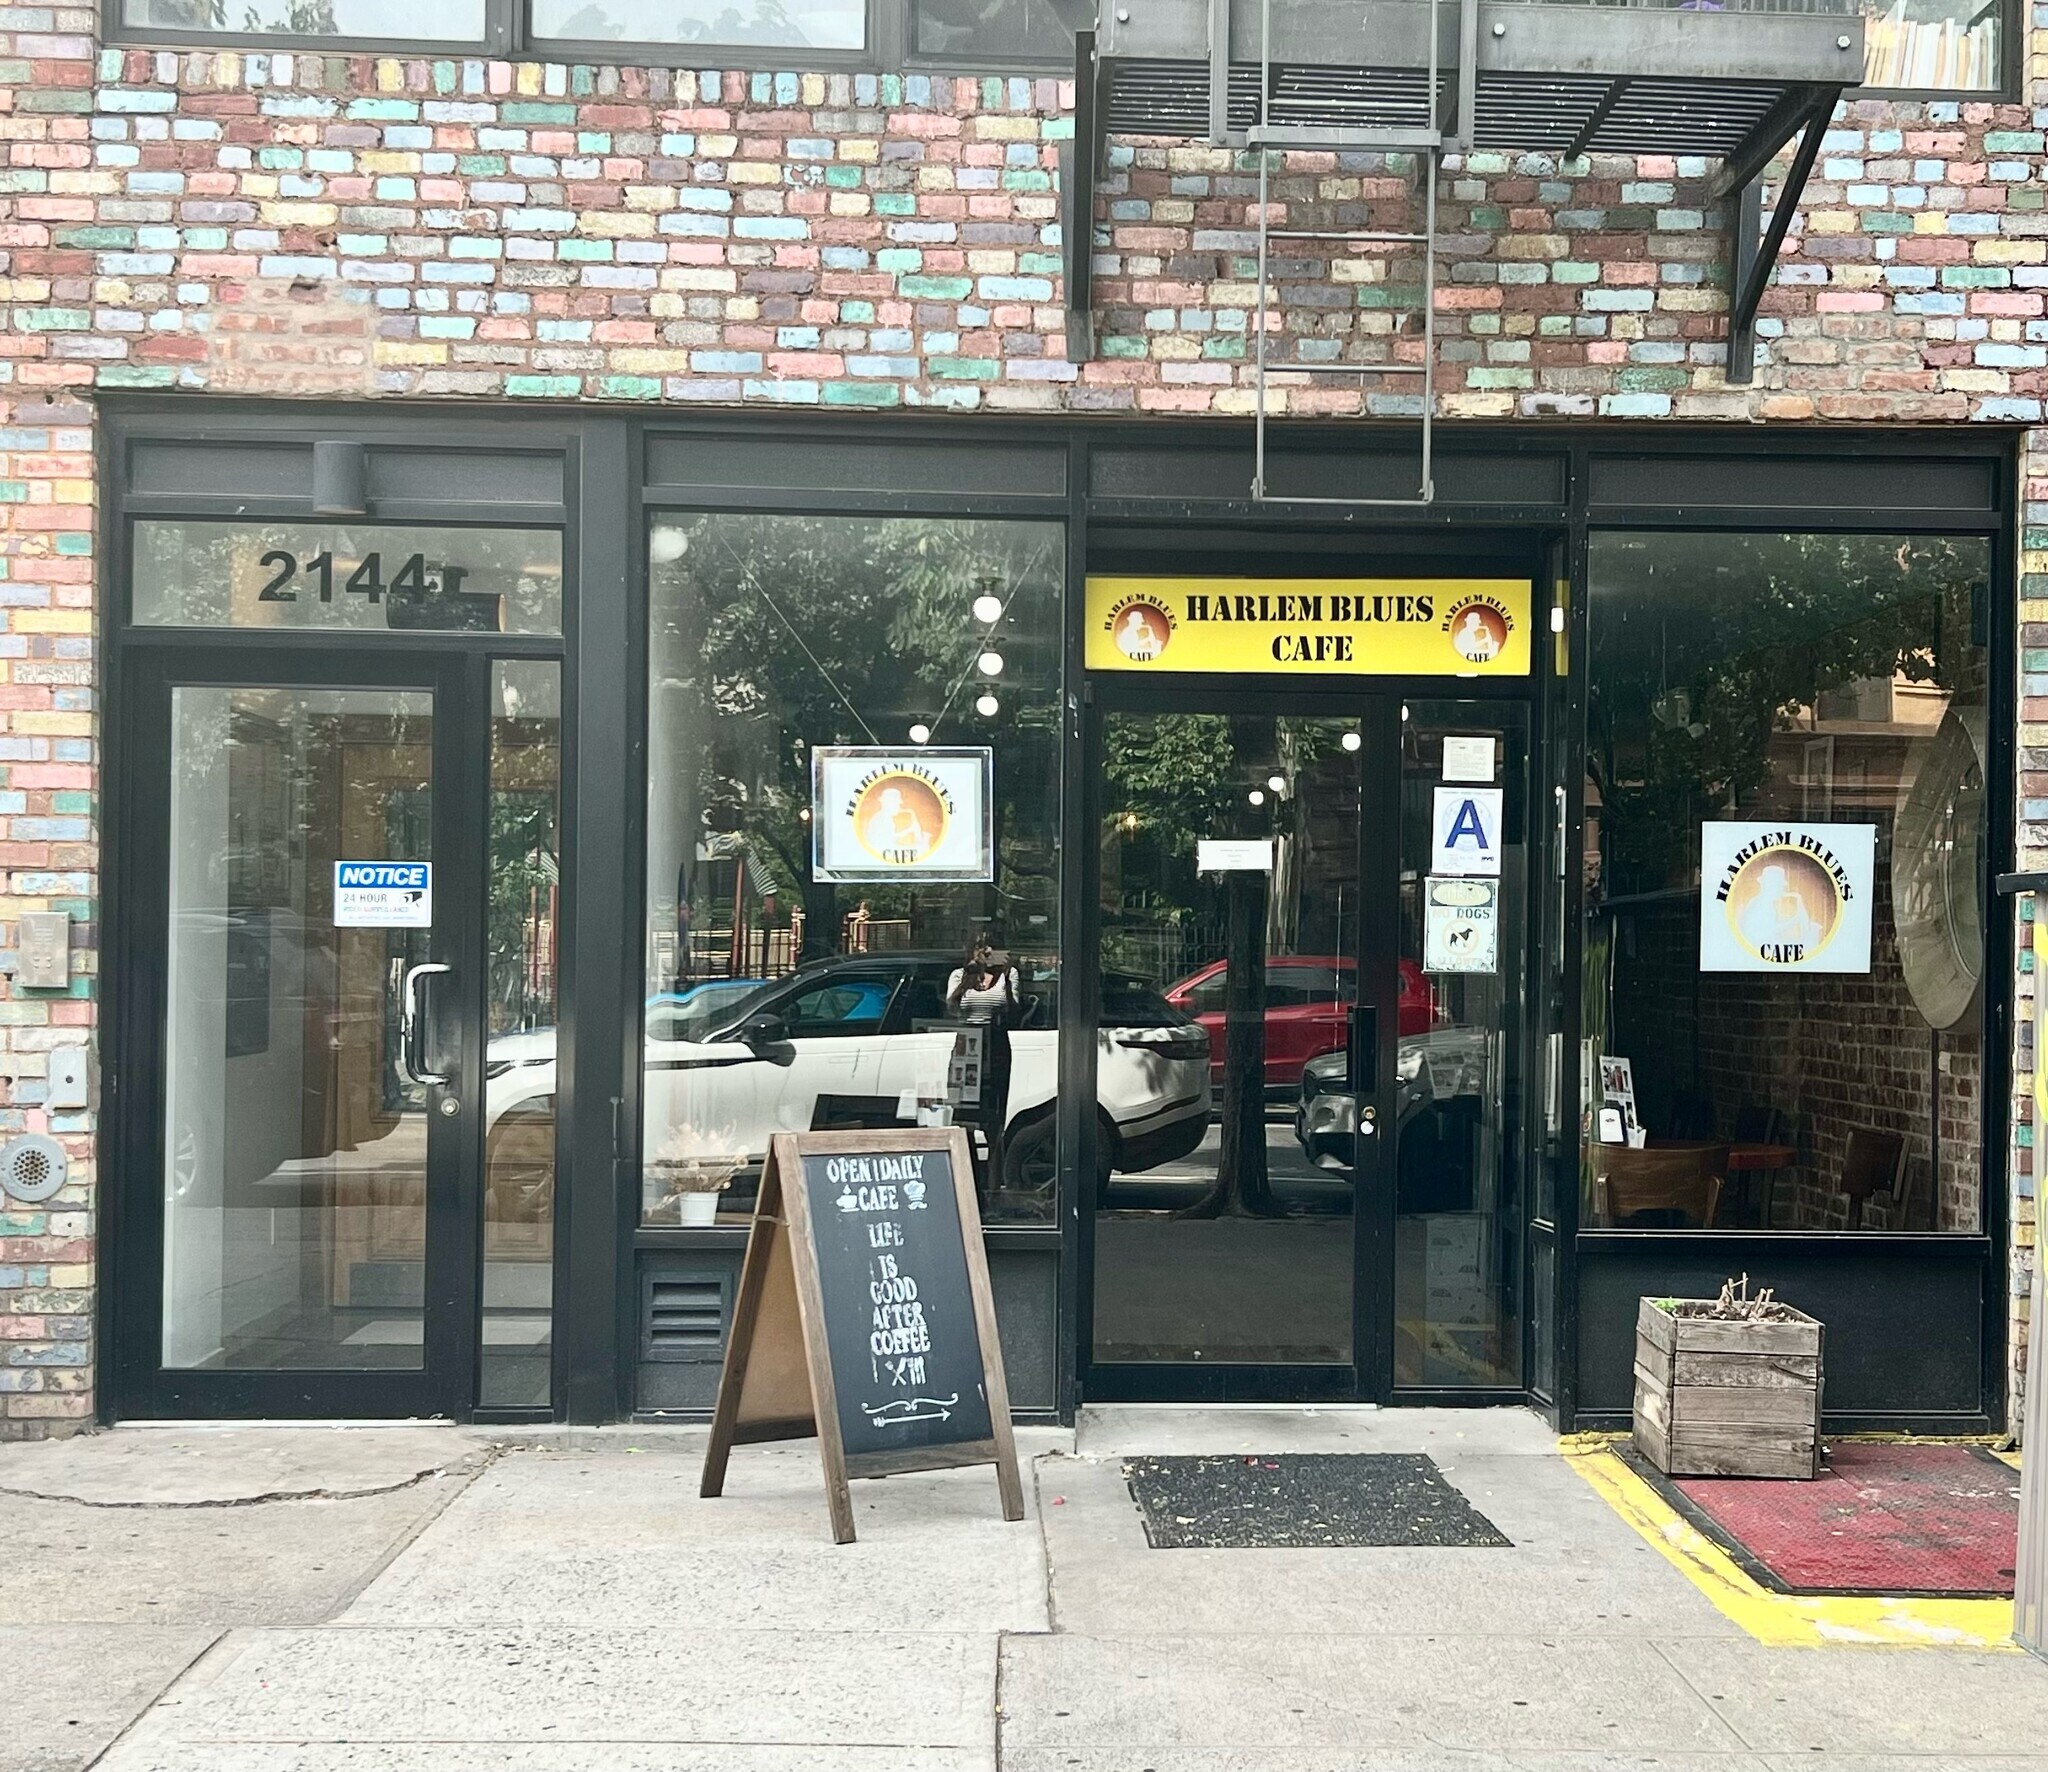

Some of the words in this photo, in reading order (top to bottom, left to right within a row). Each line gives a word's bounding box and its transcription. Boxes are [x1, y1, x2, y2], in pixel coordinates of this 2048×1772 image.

[258, 550, 426, 604] 2144
[1104, 593, 1145, 631] HARLEM
[1148, 595, 1178, 631] BLUES
[1186, 595, 1322, 622] HARLEM
[1330, 595, 1434, 622] BLUES
[1441, 594, 1483, 632] HARLEM
[1486, 597, 1515, 632] BLUES
[1129, 652, 1154, 662] CAFE
[1272, 635, 1353, 662] CAFE
[1466, 652, 1490, 663] CAFE
[846, 763, 905, 818] HARLEM
[912, 763, 957, 816] BLUES
[1444, 799, 1490, 850] A
[882, 849, 919, 864] CAFE
[1715, 831, 1792, 903] HARLEM
[1798, 833, 1854, 902] BLUES
[342, 867, 425, 886] NOTICE
[343, 893, 356, 903] 24
[359, 893, 388, 903] HOUR
[1456, 907, 1491, 920] DOGS
[1760, 943, 1804, 964] CAFE
[826, 1156, 873, 1184] OPEN
[880, 1154, 924, 1181] DAILY
[858, 1186, 899, 1212] CAFE
[867, 1221, 905, 1248] LIFE
[877, 1253, 899, 1280] IS
[870, 1276, 918, 1305] GOOD
[873, 1301, 927, 1330] AFTER
[870, 1325, 932, 1356] COFFEE
